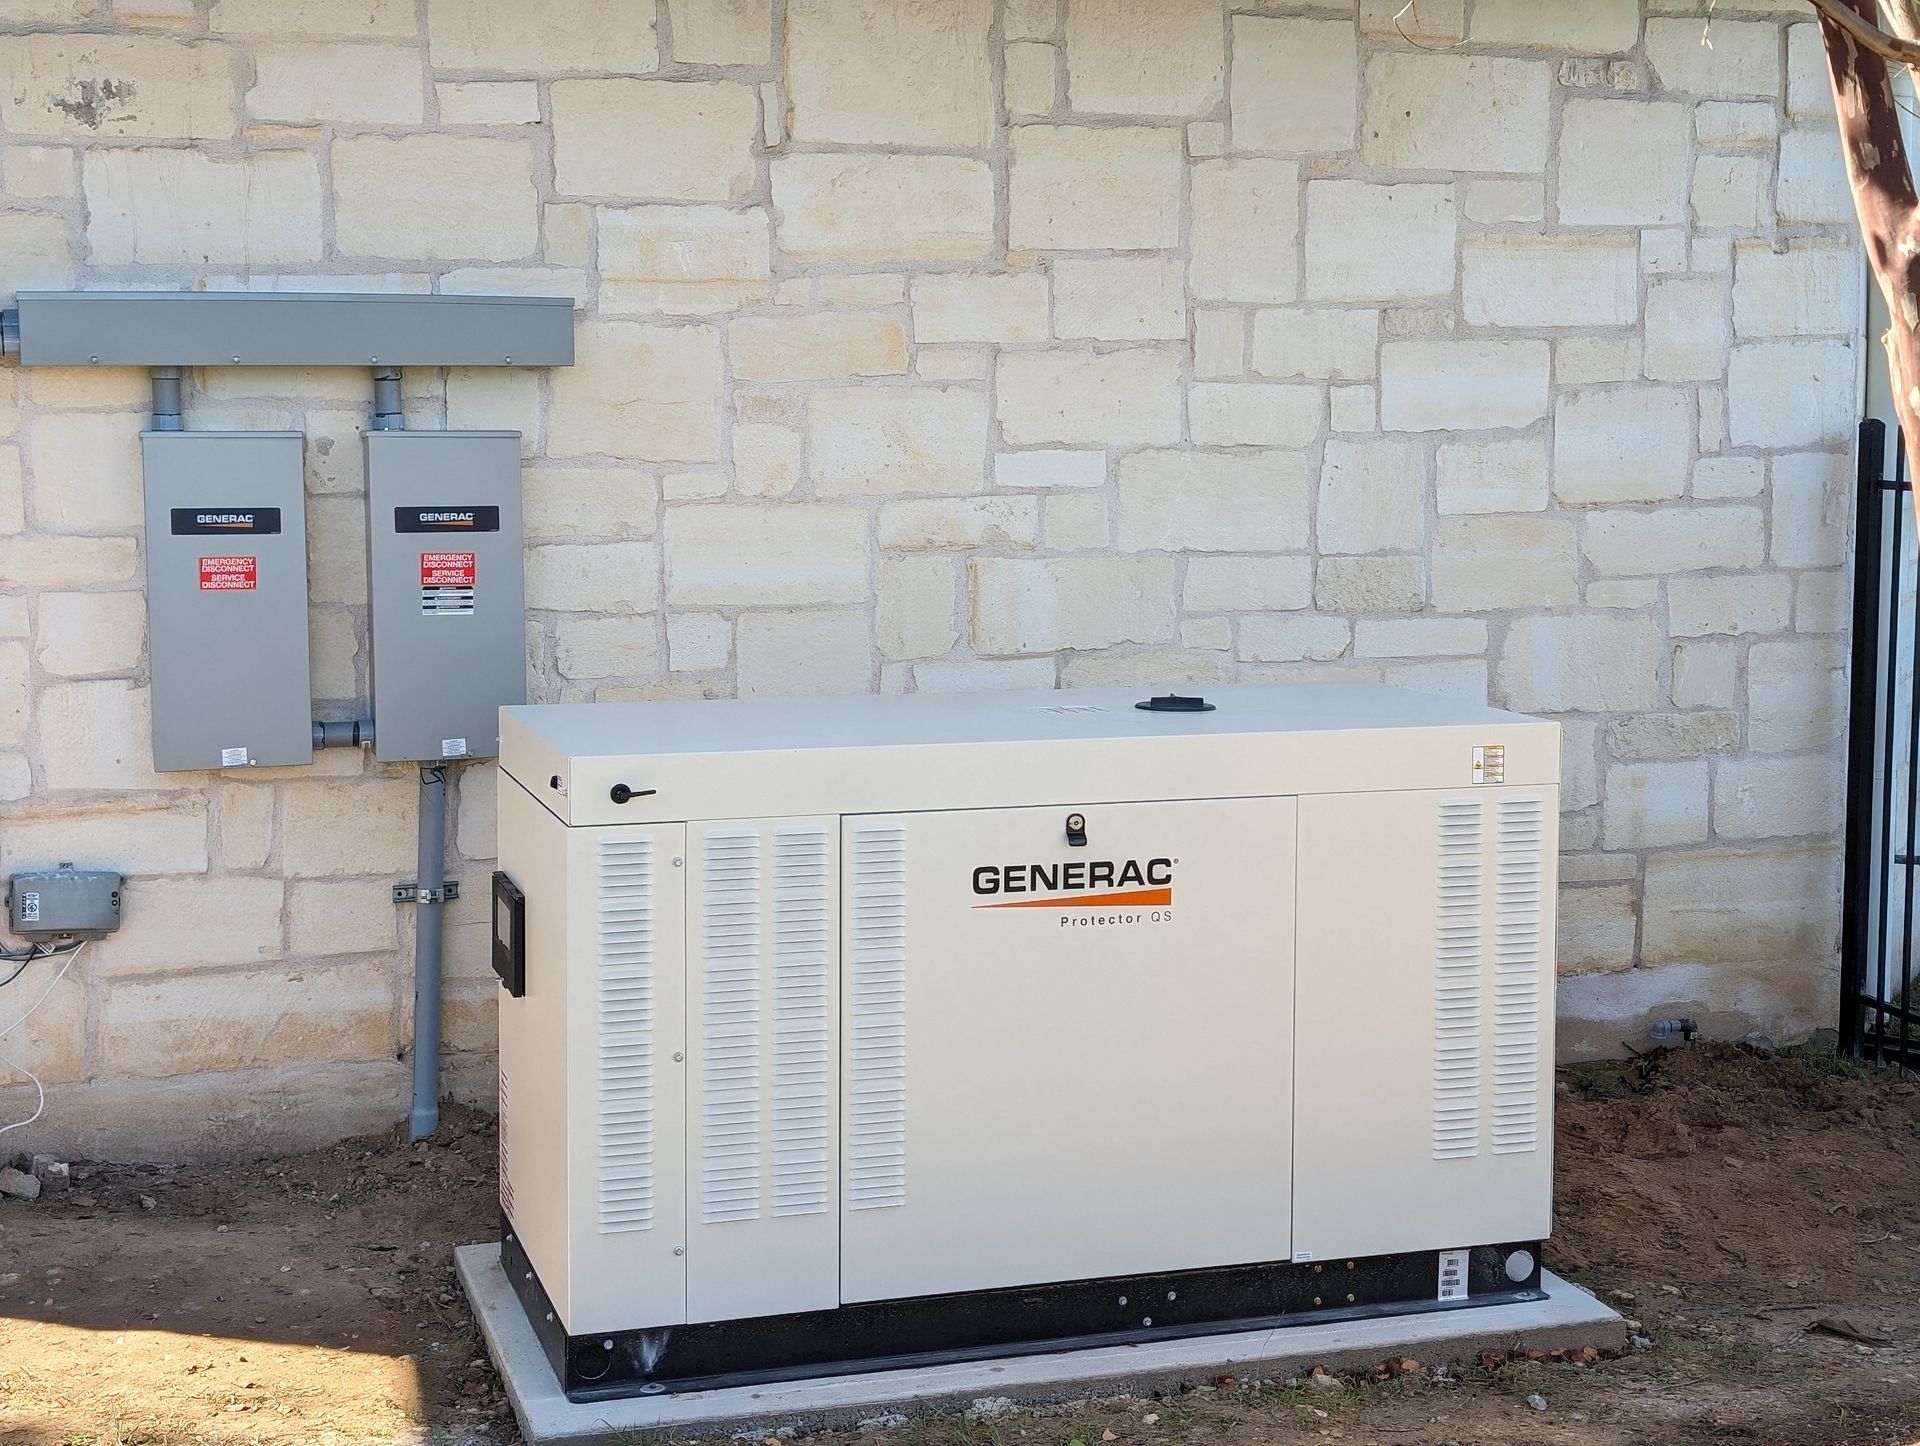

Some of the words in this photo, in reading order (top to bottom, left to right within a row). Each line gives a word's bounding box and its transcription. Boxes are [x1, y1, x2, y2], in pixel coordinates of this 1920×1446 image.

[197, 514, 253, 523] GENERAC
[419, 512, 474, 522] GENERAC
[202, 558, 254, 566] EMERGENCY
[201, 565, 255, 573] DISCONNECT
[431, 569, 465, 577] SERVICE
[211, 574, 246, 582] SERVICE
[423, 576, 474, 584] DISCONNECT
[201, 581, 255, 589] DISCONNECT
[1060, 914, 1142, 928] Protector
[1150, 910, 1173, 923] QS
